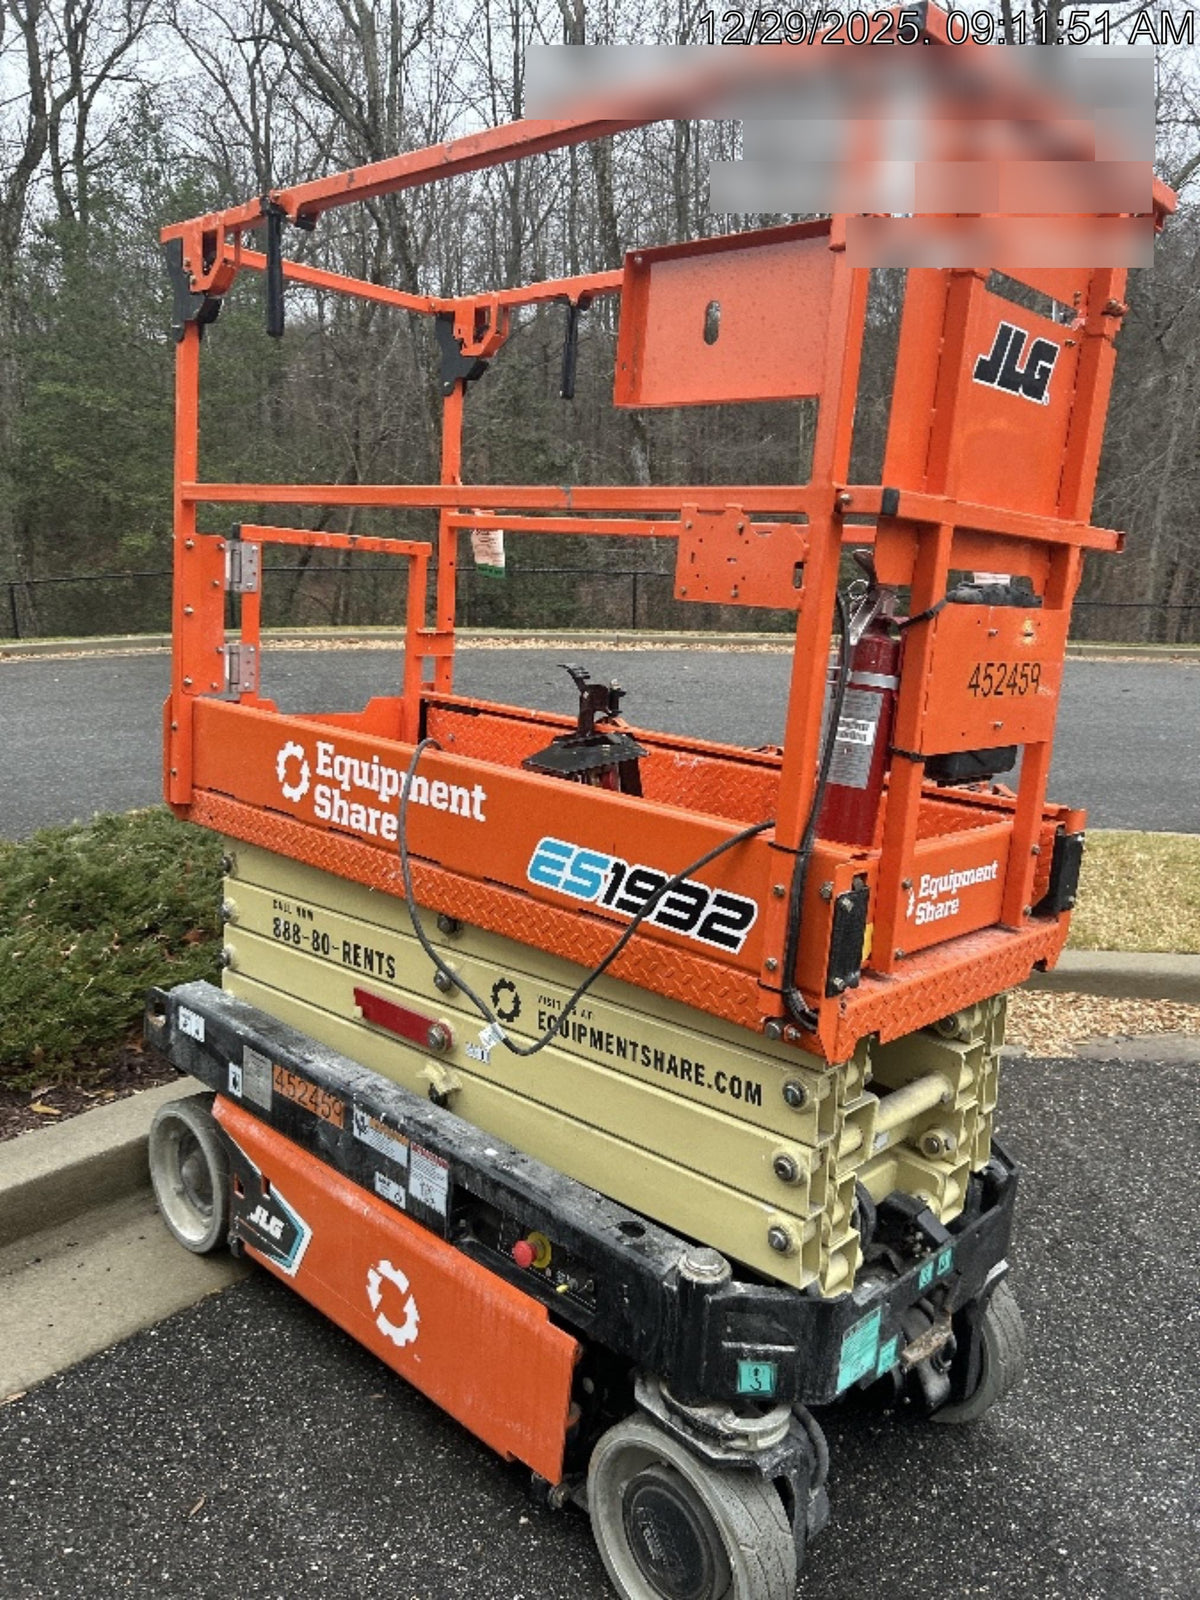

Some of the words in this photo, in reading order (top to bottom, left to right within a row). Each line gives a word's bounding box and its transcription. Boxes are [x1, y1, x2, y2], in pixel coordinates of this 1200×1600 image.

[972, 320, 1060, 404] JLG
[967, 662, 1041, 697] 452459
[316, 741, 487, 822] Equipment
[314, 784, 400, 841] Share
[527, 836, 758, 954] ES1932
[918, 860, 998, 900] Equipment
[915, 897, 960, 926] Share
[273, 917, 396, 980] 888-80-RENTS
[538, 1009, 762, 1106] EQUIPMENTSHARE.COM
[274, 1068, 343, 1127] 452459
[247, 1204, 285, 1240] JLG
